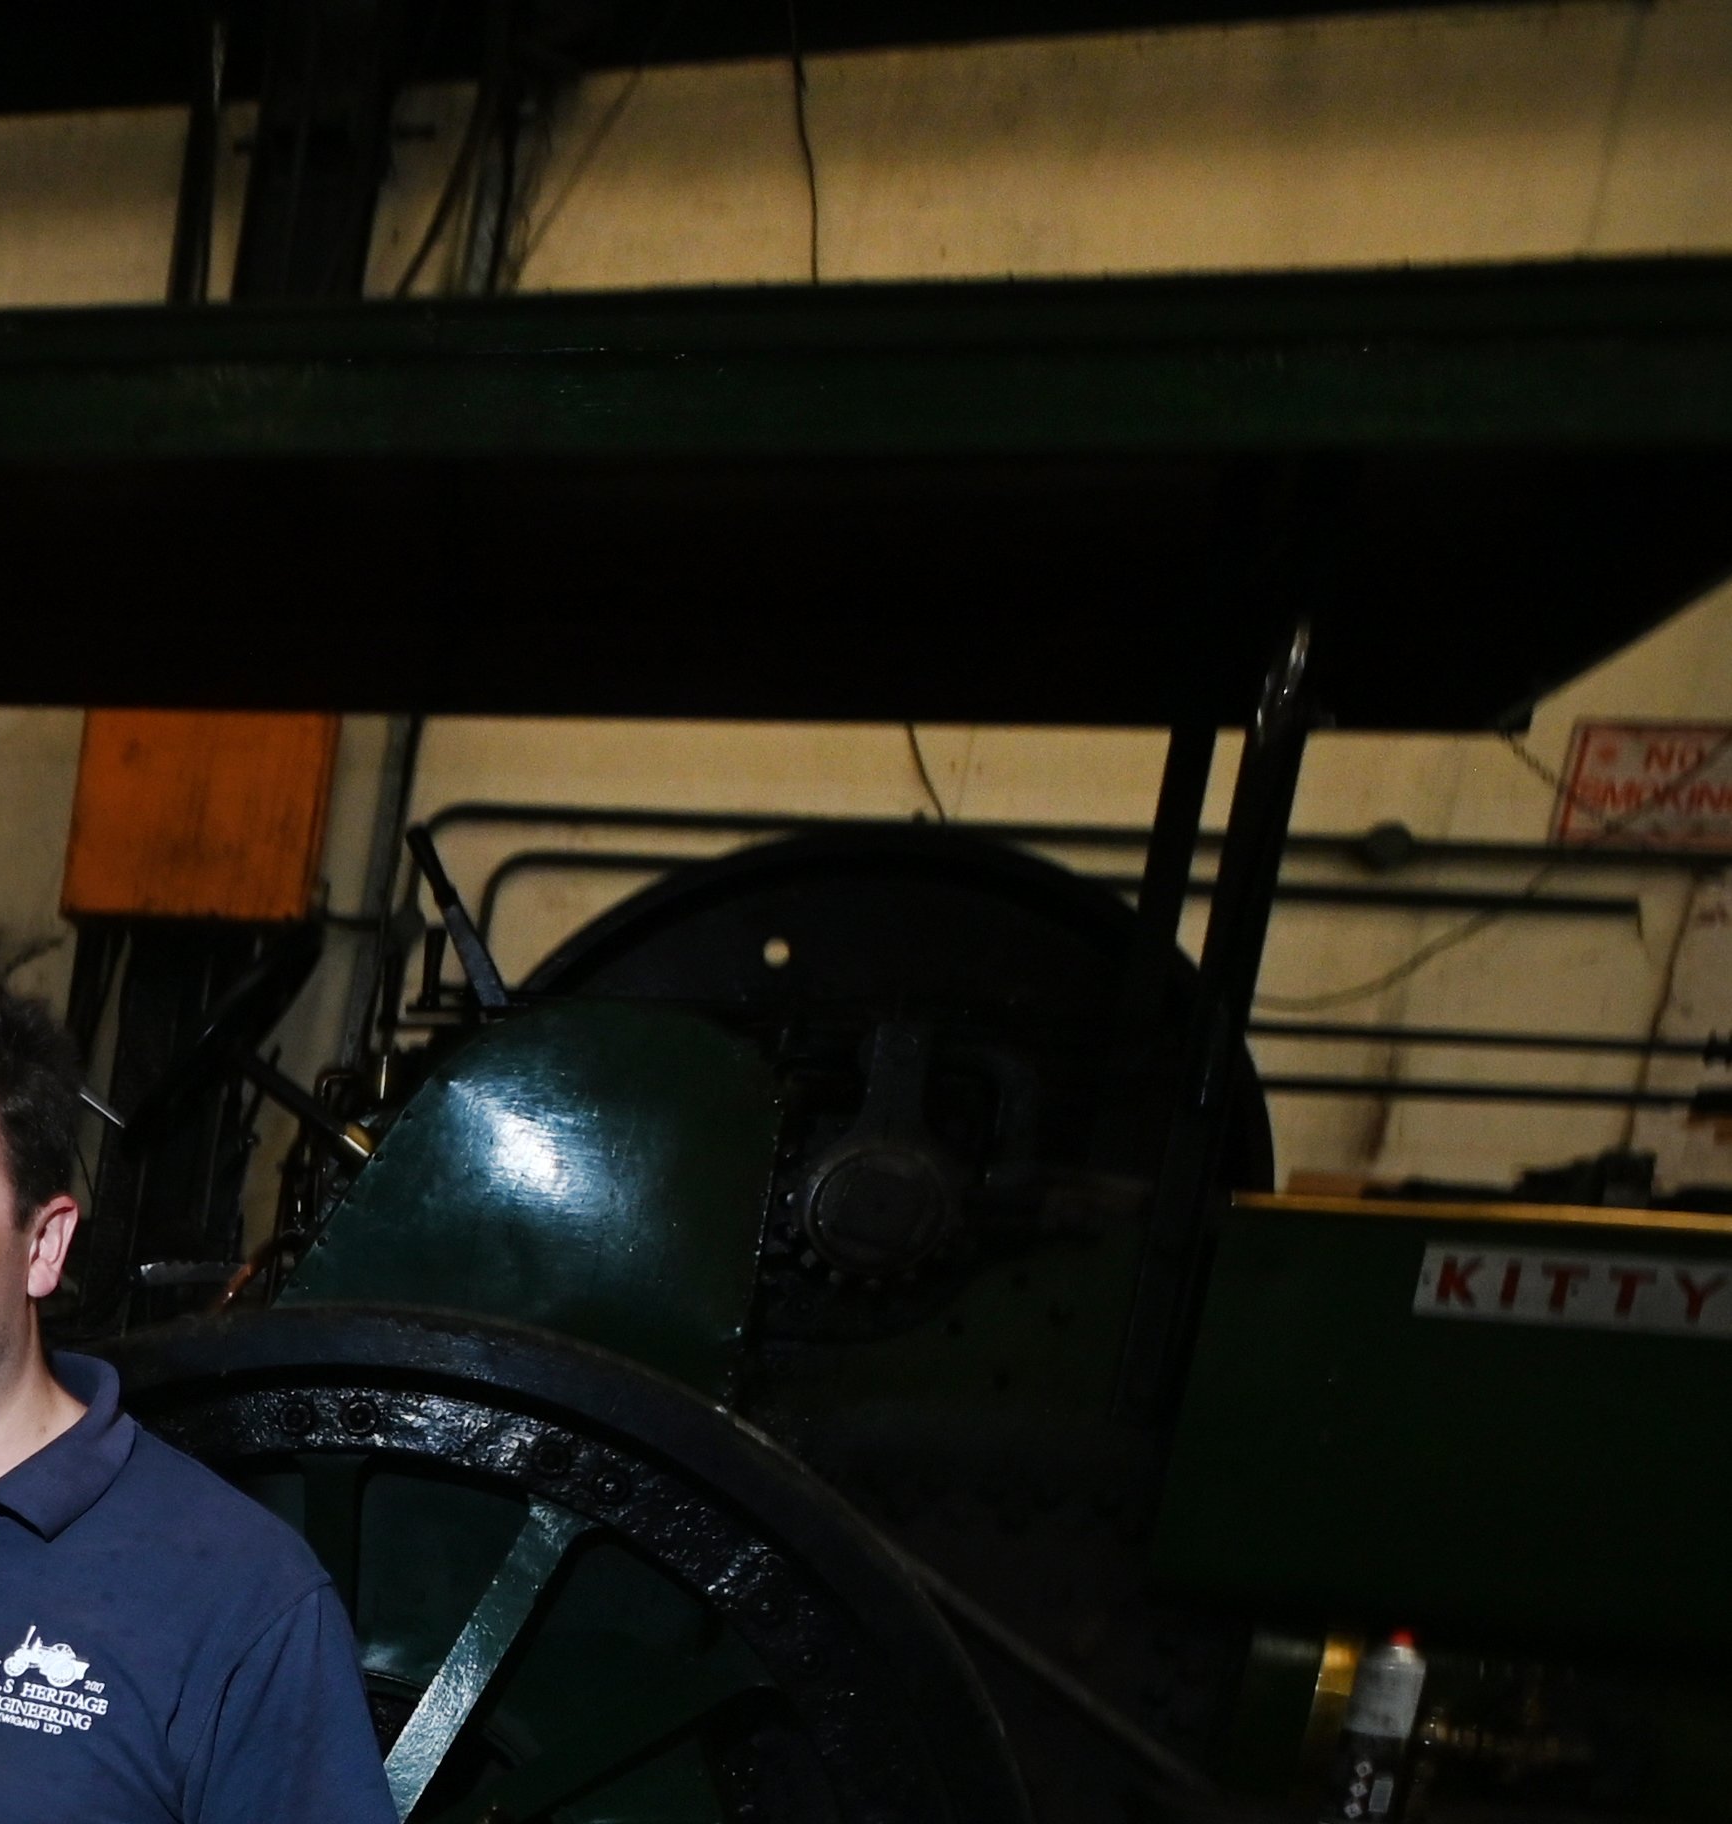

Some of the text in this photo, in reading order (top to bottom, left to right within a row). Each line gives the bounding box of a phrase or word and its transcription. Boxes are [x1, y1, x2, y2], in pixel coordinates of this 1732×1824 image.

[1644, 745, 1706, 772] NO
[1575, 775, 1732, 816] SMOKIN
[1437, 1254, 1732, 1323] KITTY
[20, 1682, 109, 1716] HERITAGE
[42, 1722, 63, 1735] LTD
